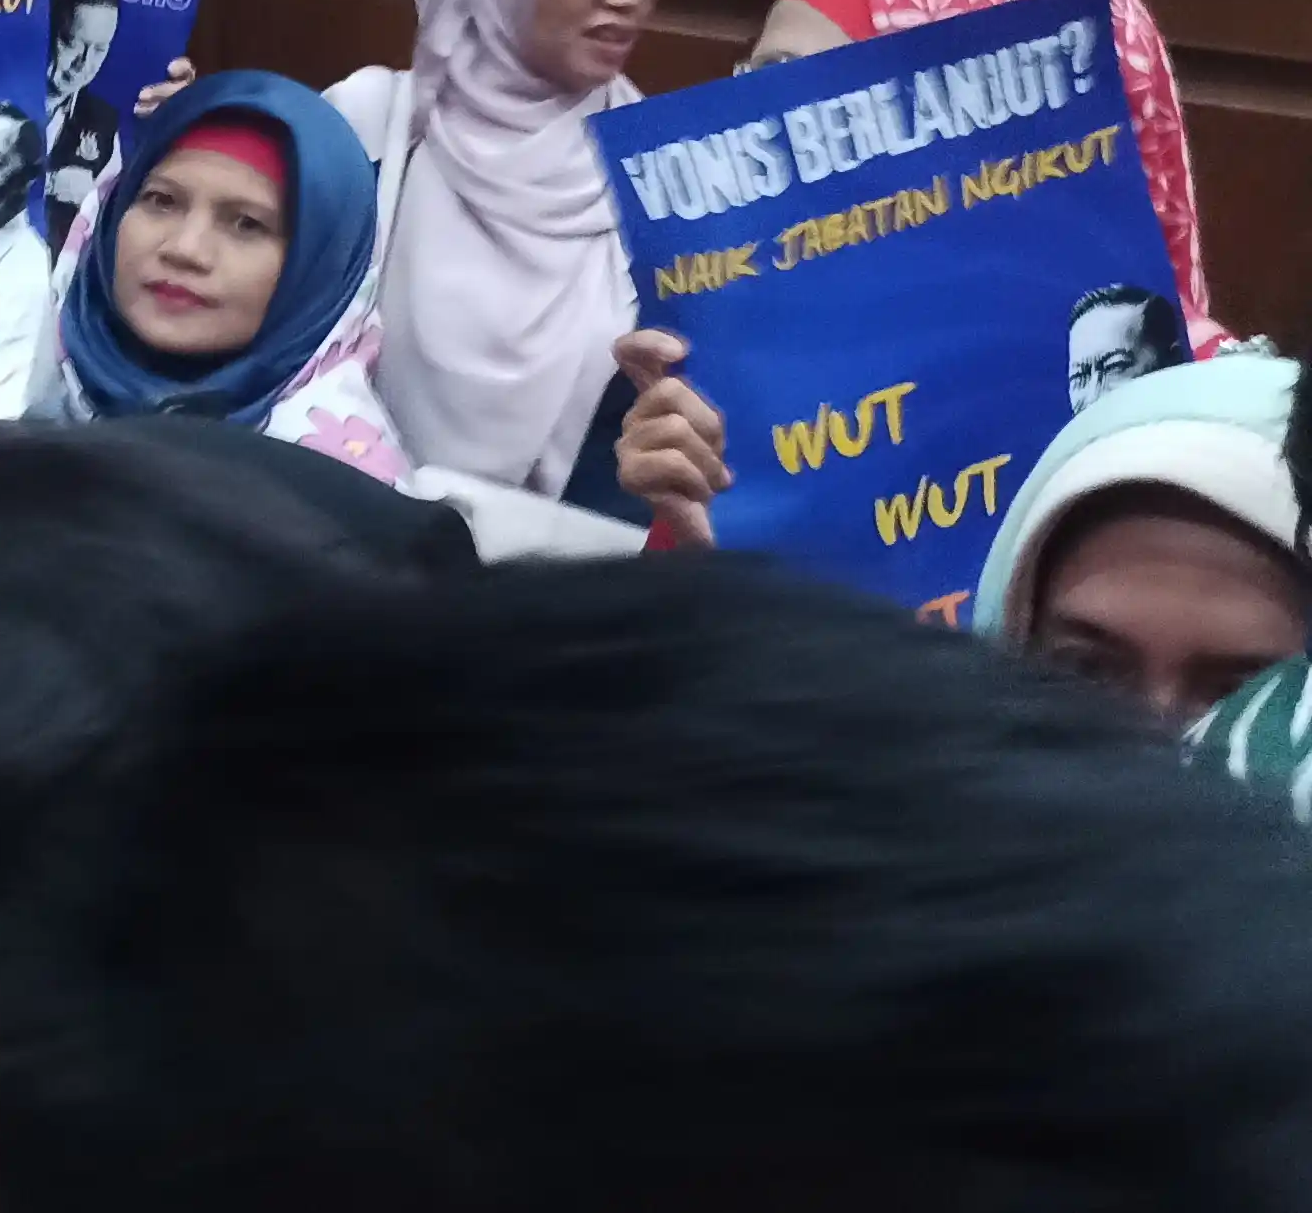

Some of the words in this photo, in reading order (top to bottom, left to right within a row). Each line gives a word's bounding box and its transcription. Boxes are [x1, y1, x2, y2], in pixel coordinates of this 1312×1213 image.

[621, 118, 793, 221] VONIS
[783, 19, 1098, 184] BERLANJUT?
[655, 242, 761, 301] NAIK
[772, 175, 952, 272] JABATAN
[962, 125, 1121, 210] NGIKUT
[772, 381, 918, 475] WUT
[874, 453, 1013, 546] WUT
